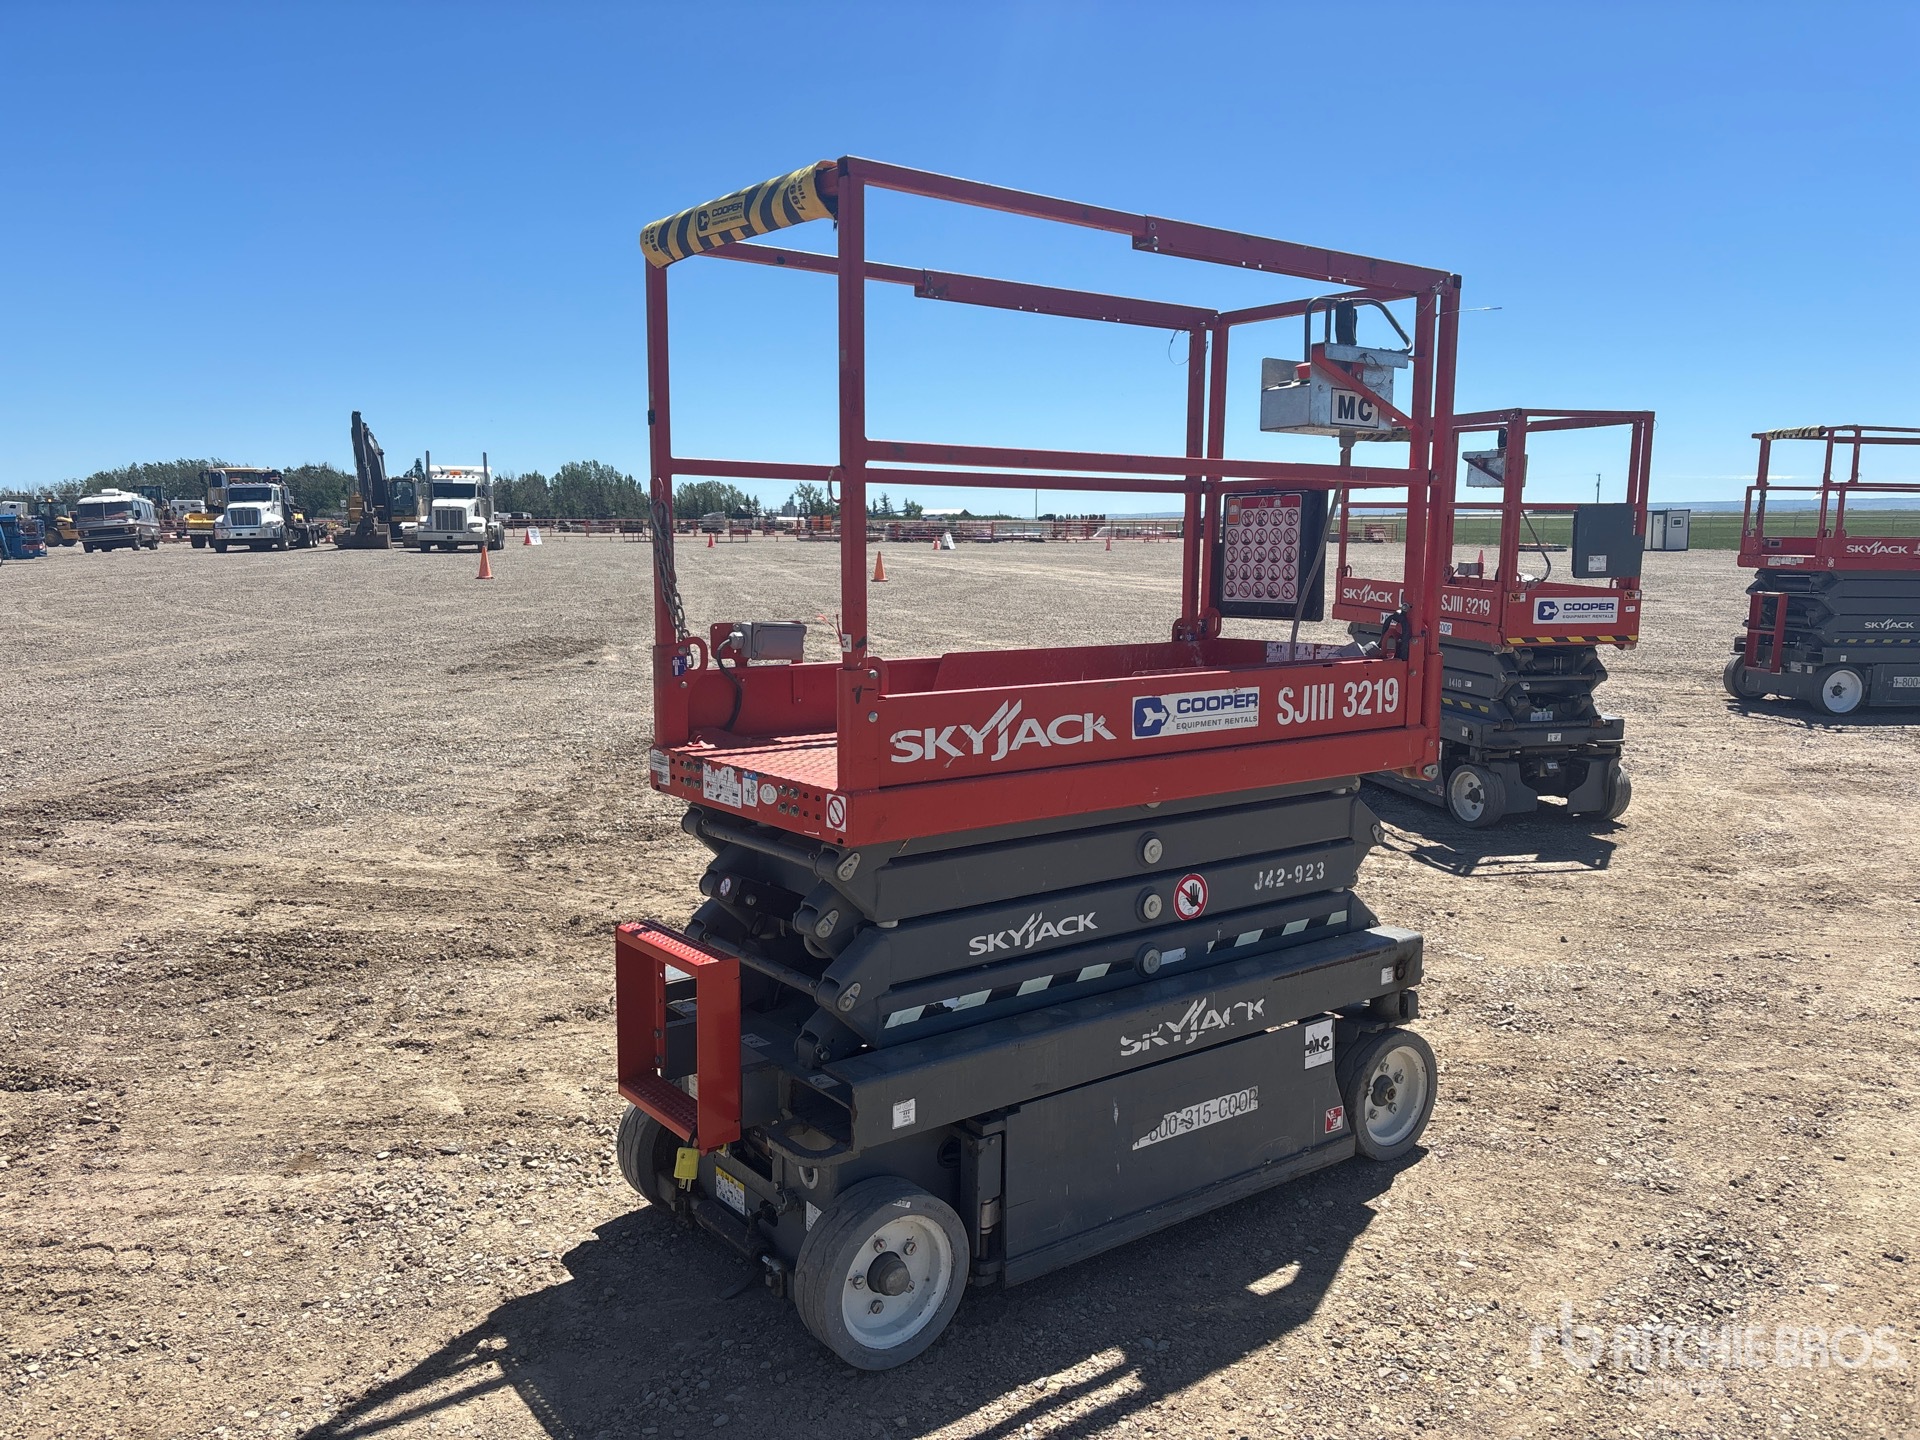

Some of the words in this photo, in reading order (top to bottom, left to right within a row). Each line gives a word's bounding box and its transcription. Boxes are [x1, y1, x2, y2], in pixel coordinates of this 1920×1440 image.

[712, 202, 743, 217] COOPER
[1338, 395, 1373, 421] MC
[1846, 541, 1908, 555] SKYJACK
[1343, 584, 1393, 603] SKYJACK
[1441, 594, 1463, 612] SJIII
[1466, 597, 1490, 616] 3219
[1563, 603, 1615, 611] COOPER
[1864, 618, 1914, 630] SKYJACK
[1177, 693, 1258, 714] COOPER
[1277, 683, 1334, 725] SJIII
[1343, 678, 1399, 718] 3219
[890, 699, 1117, 763] SKYJACK
[1176, 719, 1222, 730] EQUIPMENT
[1224, 715, 1258, 725] RENTALS
[1254, 861, 1325, 890] J42-923
[969, 911, 1098, 956] SKYJACK
